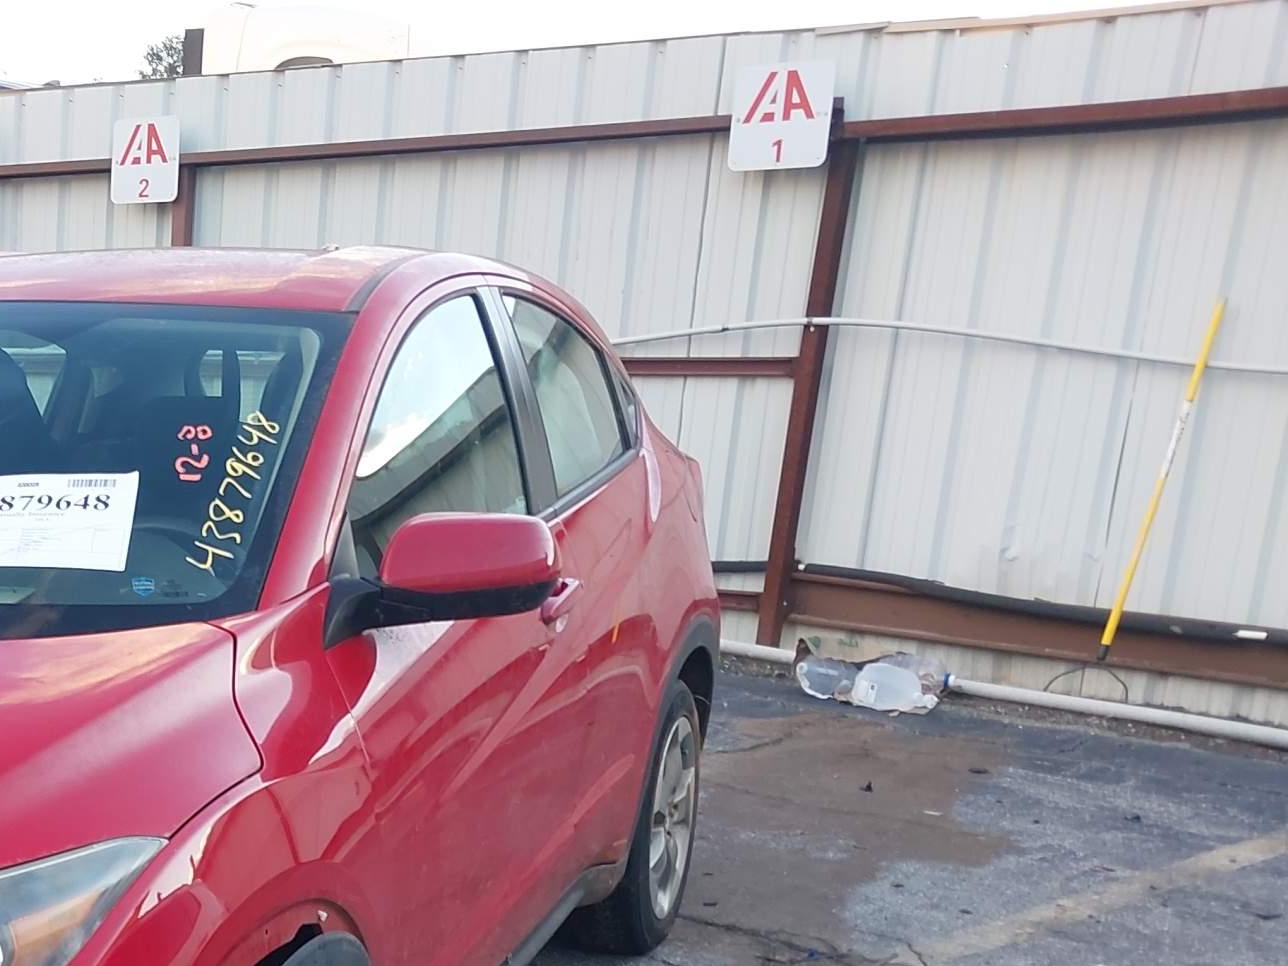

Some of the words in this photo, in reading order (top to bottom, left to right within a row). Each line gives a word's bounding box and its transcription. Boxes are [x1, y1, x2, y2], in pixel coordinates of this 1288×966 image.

[771, 138, 783, 163] 1
[138, 178, 150, 198] 2
[175, 424, 213, 482] 12-8
[185, 410, 281, 577] 43879648
